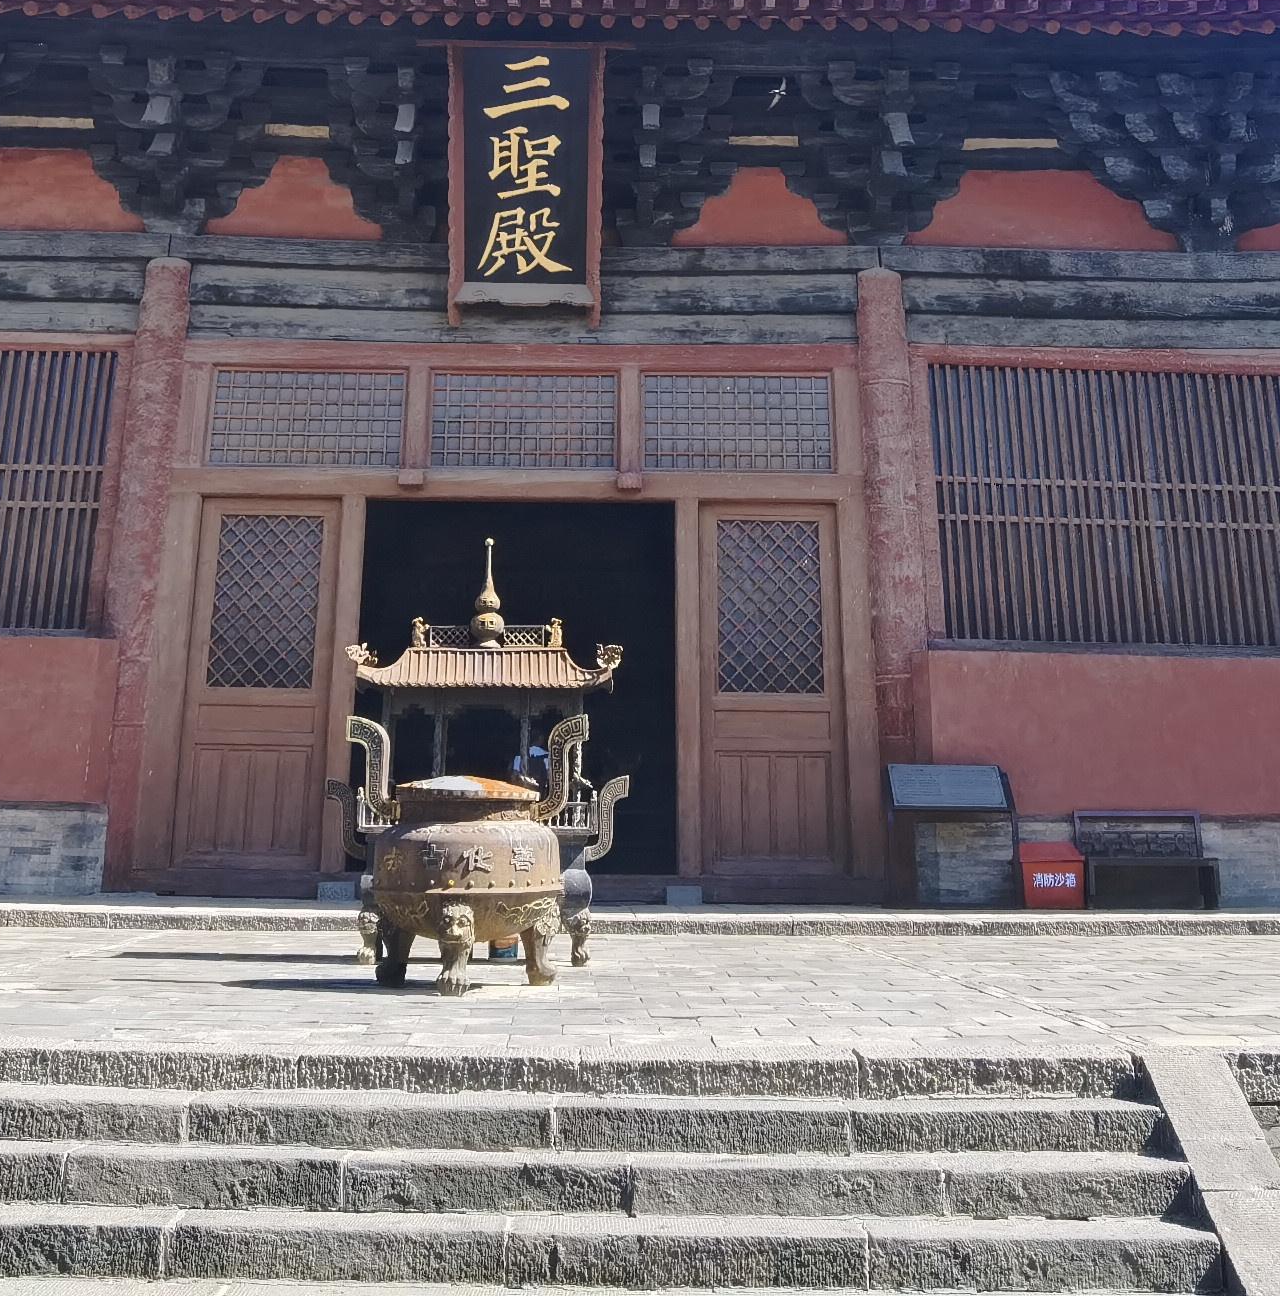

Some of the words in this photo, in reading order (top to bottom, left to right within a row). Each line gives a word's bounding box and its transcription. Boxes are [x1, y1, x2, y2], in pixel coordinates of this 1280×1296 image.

[477, 55, 573, 277] 三聖殿
[1032, 872, 1076, 888] 消防沙箱
